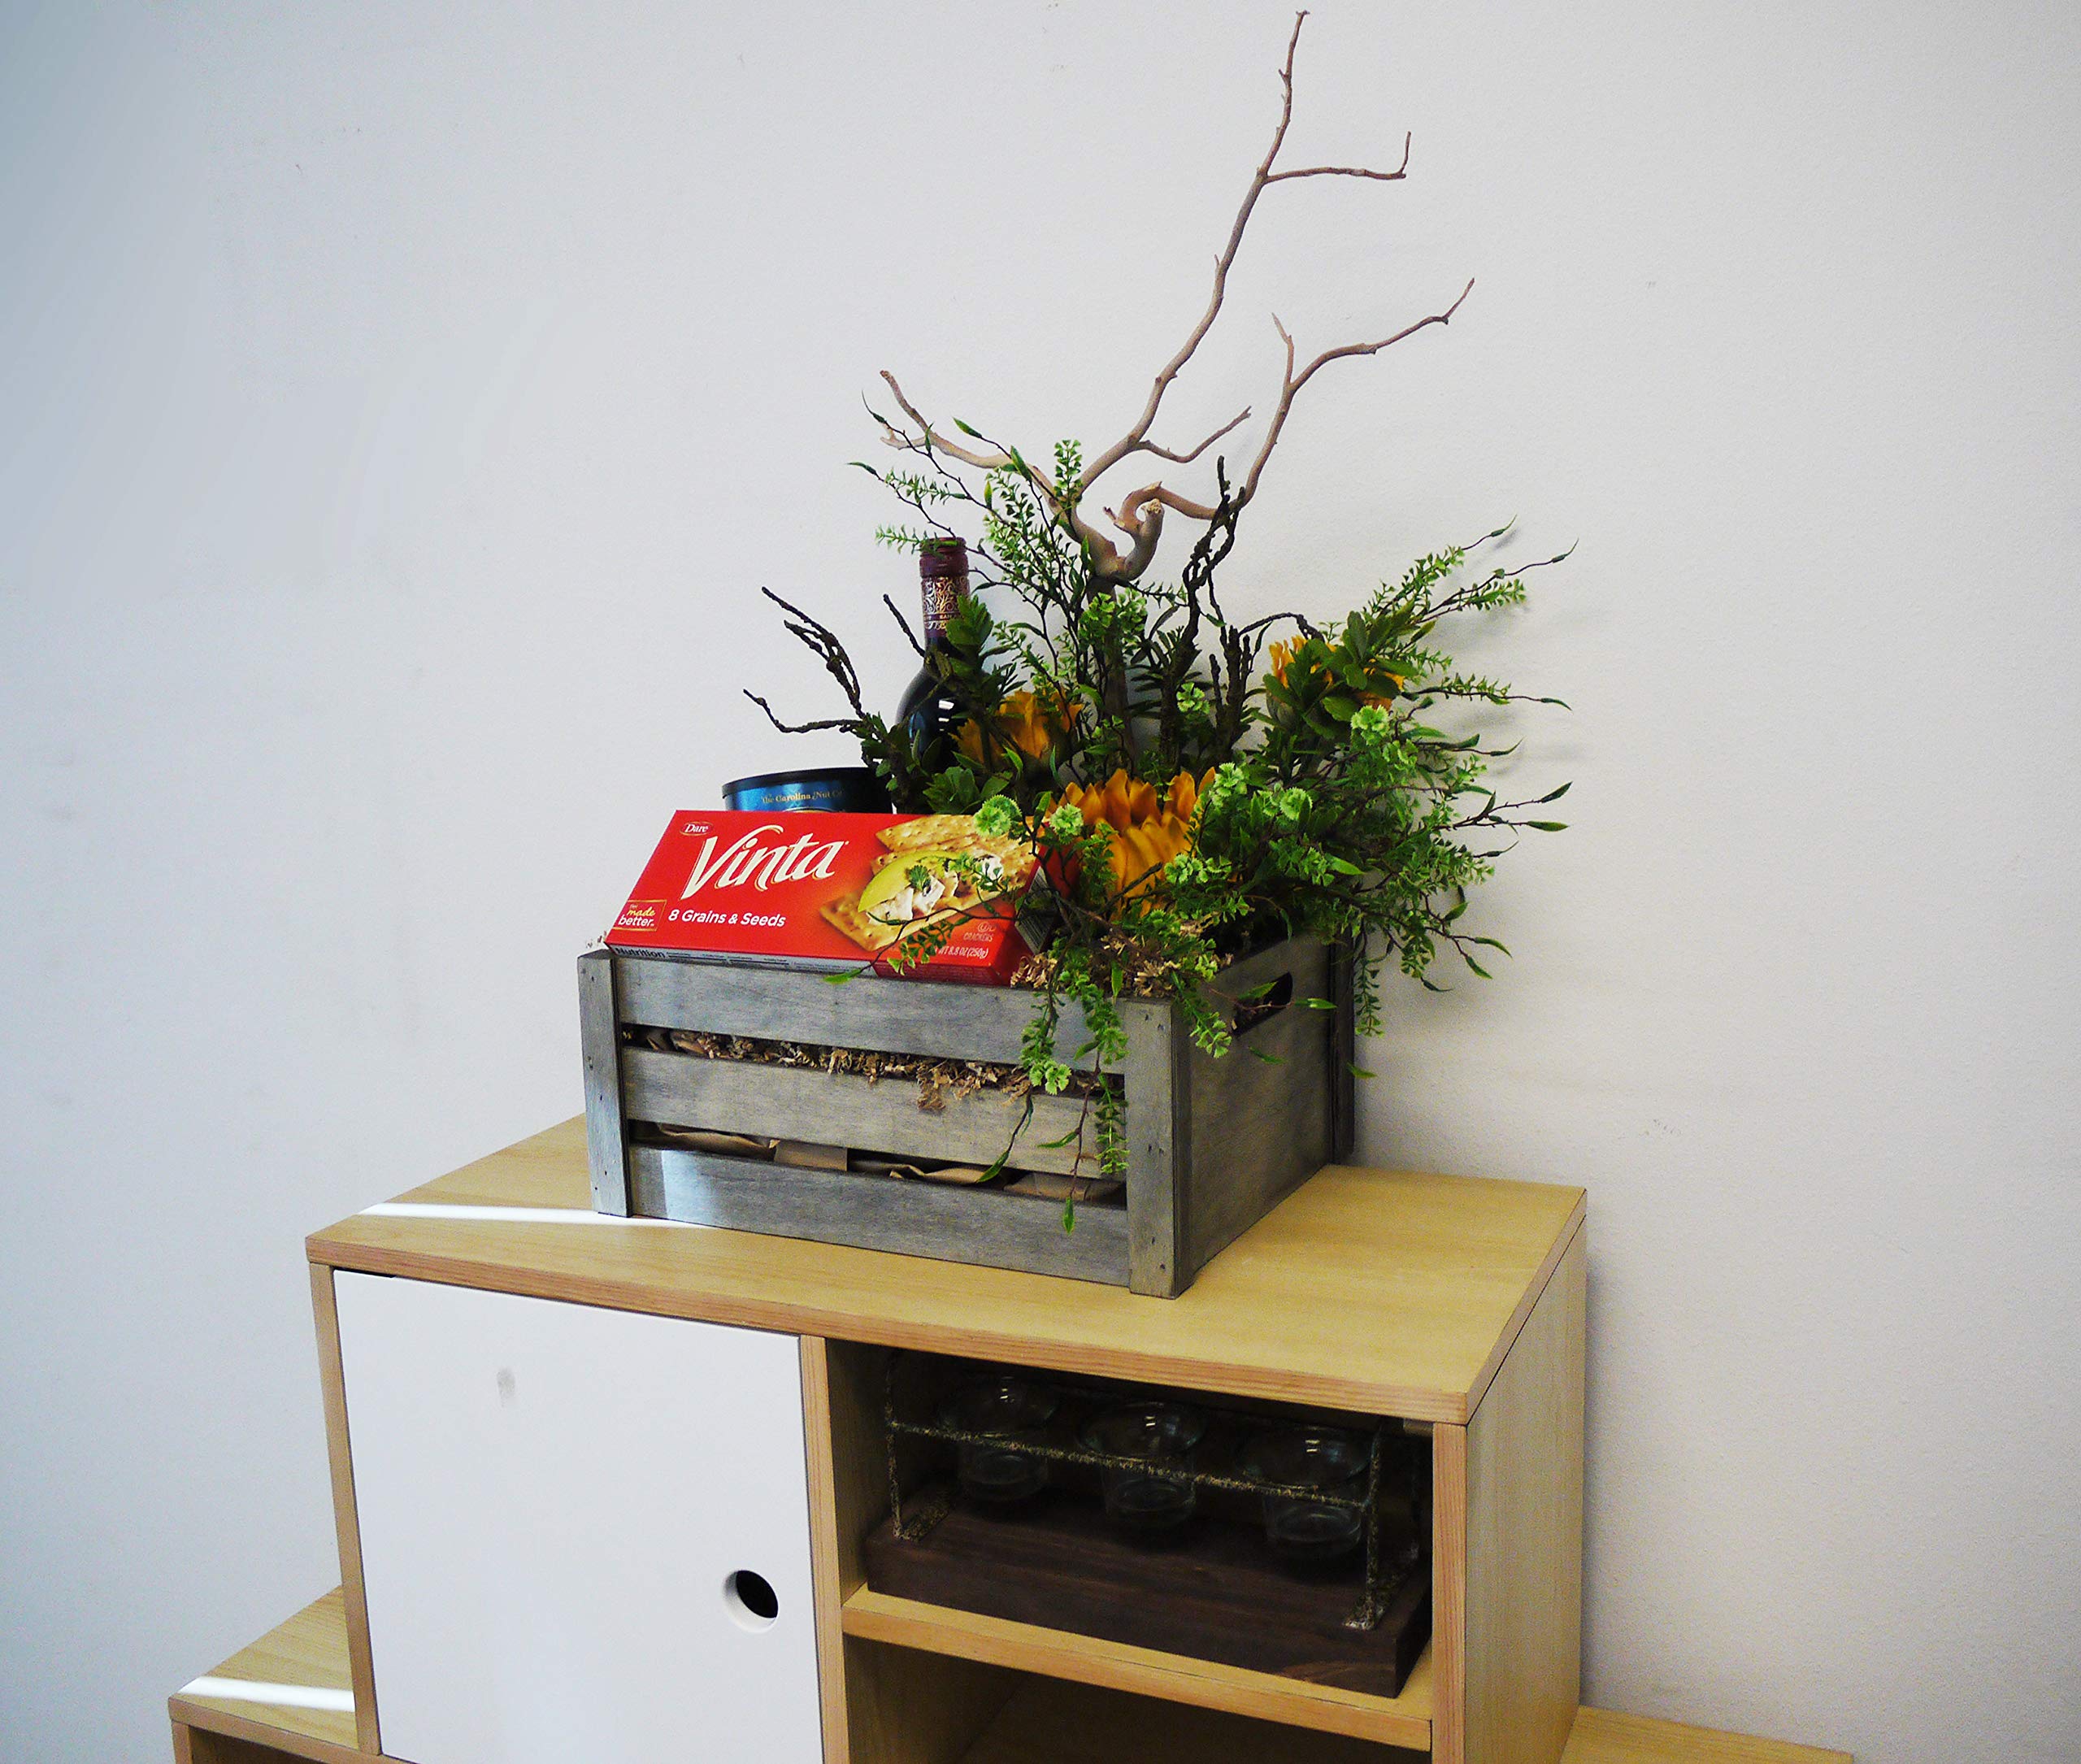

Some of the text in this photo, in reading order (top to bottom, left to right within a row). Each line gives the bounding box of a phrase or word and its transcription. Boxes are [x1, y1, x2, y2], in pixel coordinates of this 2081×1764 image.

[775, 793, 811, 802] Carolina
[684, 823, 709, 833] Dare
[679, 824, 845, 901] Vinta
[626, 906, 656, 916] made
[668, 909, 786, 927] 8 Grains & Seeds
[615, 947, 666, 958] Nutrition
